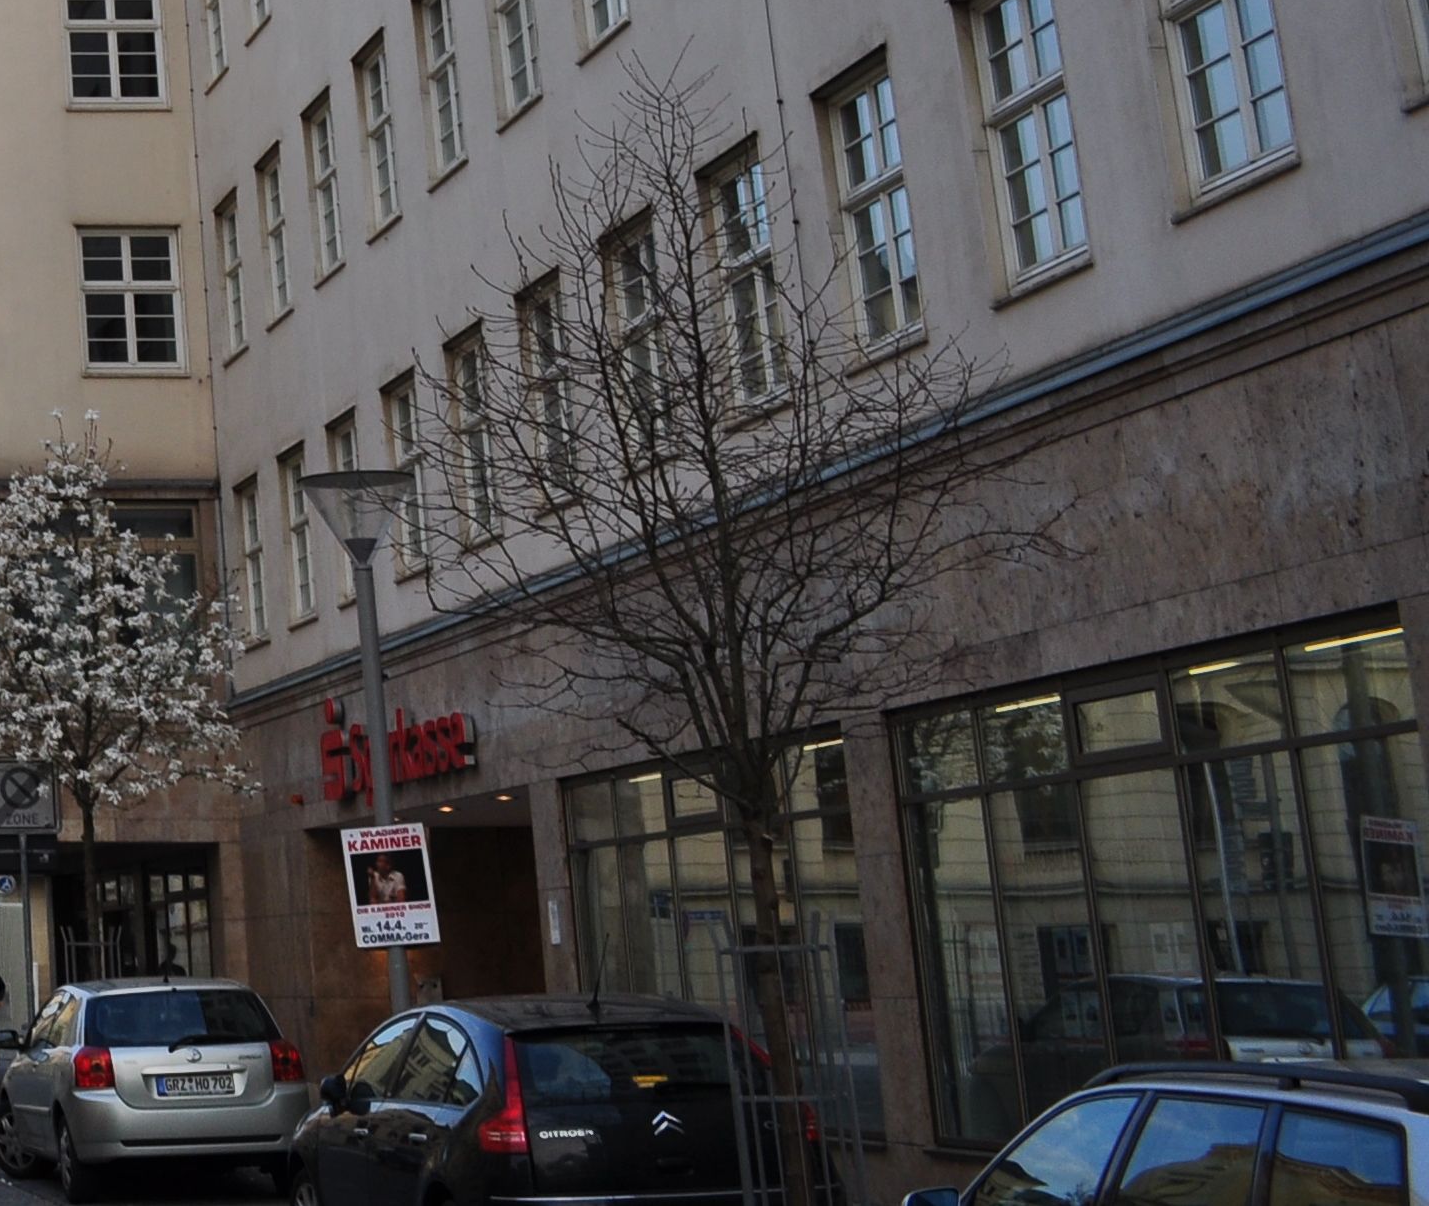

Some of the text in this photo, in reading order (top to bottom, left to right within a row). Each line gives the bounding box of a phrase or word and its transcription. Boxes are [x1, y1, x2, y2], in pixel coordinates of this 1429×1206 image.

[349, 707, 469, 807] Sprkasse
[5, 813, 39, 825] ZONE
[360, 827, 409, 838] WLADIMIR
[347, 835, 421, 852] KAMINER
[376, 920, 406, 932] 14.4.
[362, 932, 429, 944] COMMA-Gera
[165, 1077, 186, 1091] GRZ
[212, 1076, 232, 1089] 702
